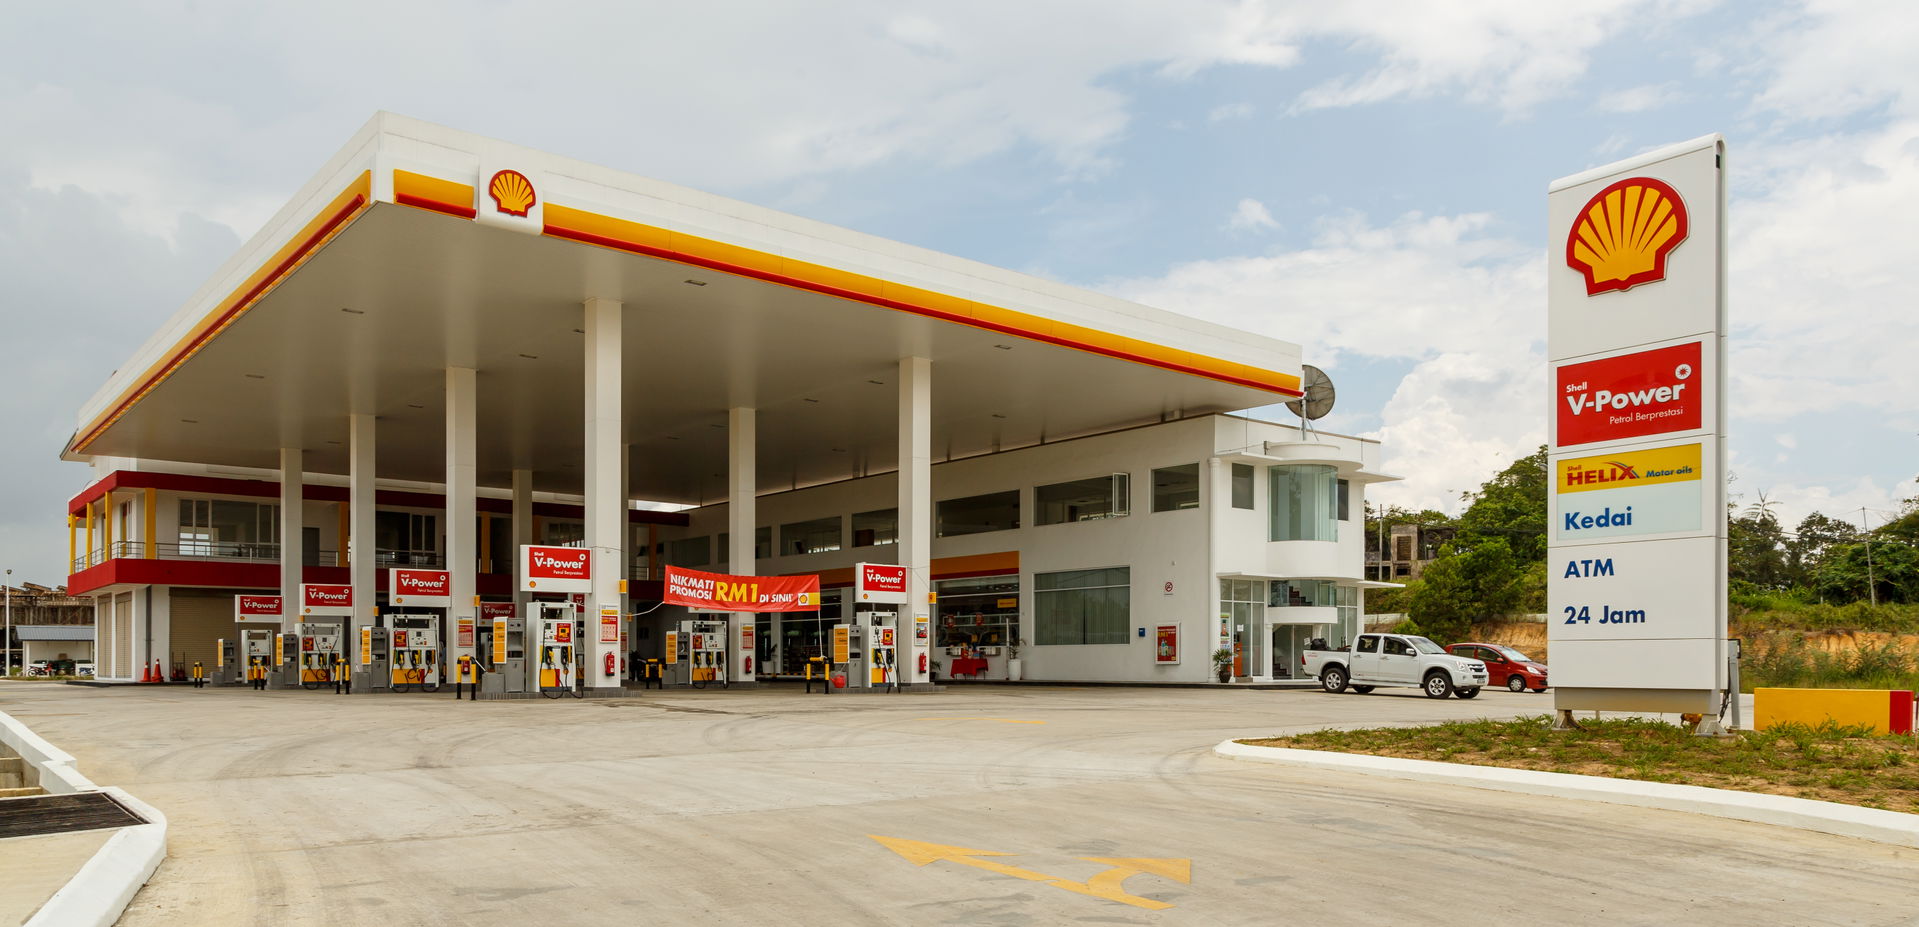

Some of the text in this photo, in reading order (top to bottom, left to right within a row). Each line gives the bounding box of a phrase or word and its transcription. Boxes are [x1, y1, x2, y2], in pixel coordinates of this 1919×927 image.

[1566, 381, 1588, 393] Shell
[1566, 383, 1686, 416] V-Power
[1609, 406, 1684, 425] Petrol Berprestasi
[1566, 465, 1693, 486] HELIX Motor oils
[1567, 464, 1582, 472] Shell
[1565, 506, 1632, 531] Kedai
[534, 556, 584, 569] V-Power
[1564, 558, 1615, 579] ATM
[401, 578, 444, 588] V-Power
[670, 573, 715, 590] NIKMATI
[866, 573, 902, 584] V-Power
[309, 591, 348, 600] V-Power
[715, 581, 758, 603] RM1
[759, 594, 769, 603] DI
[243, 601, 278, 609] V-Power
[484, 607, 512, 615] V-Power
[1564, 605, 1646, 625] 24 Jam
